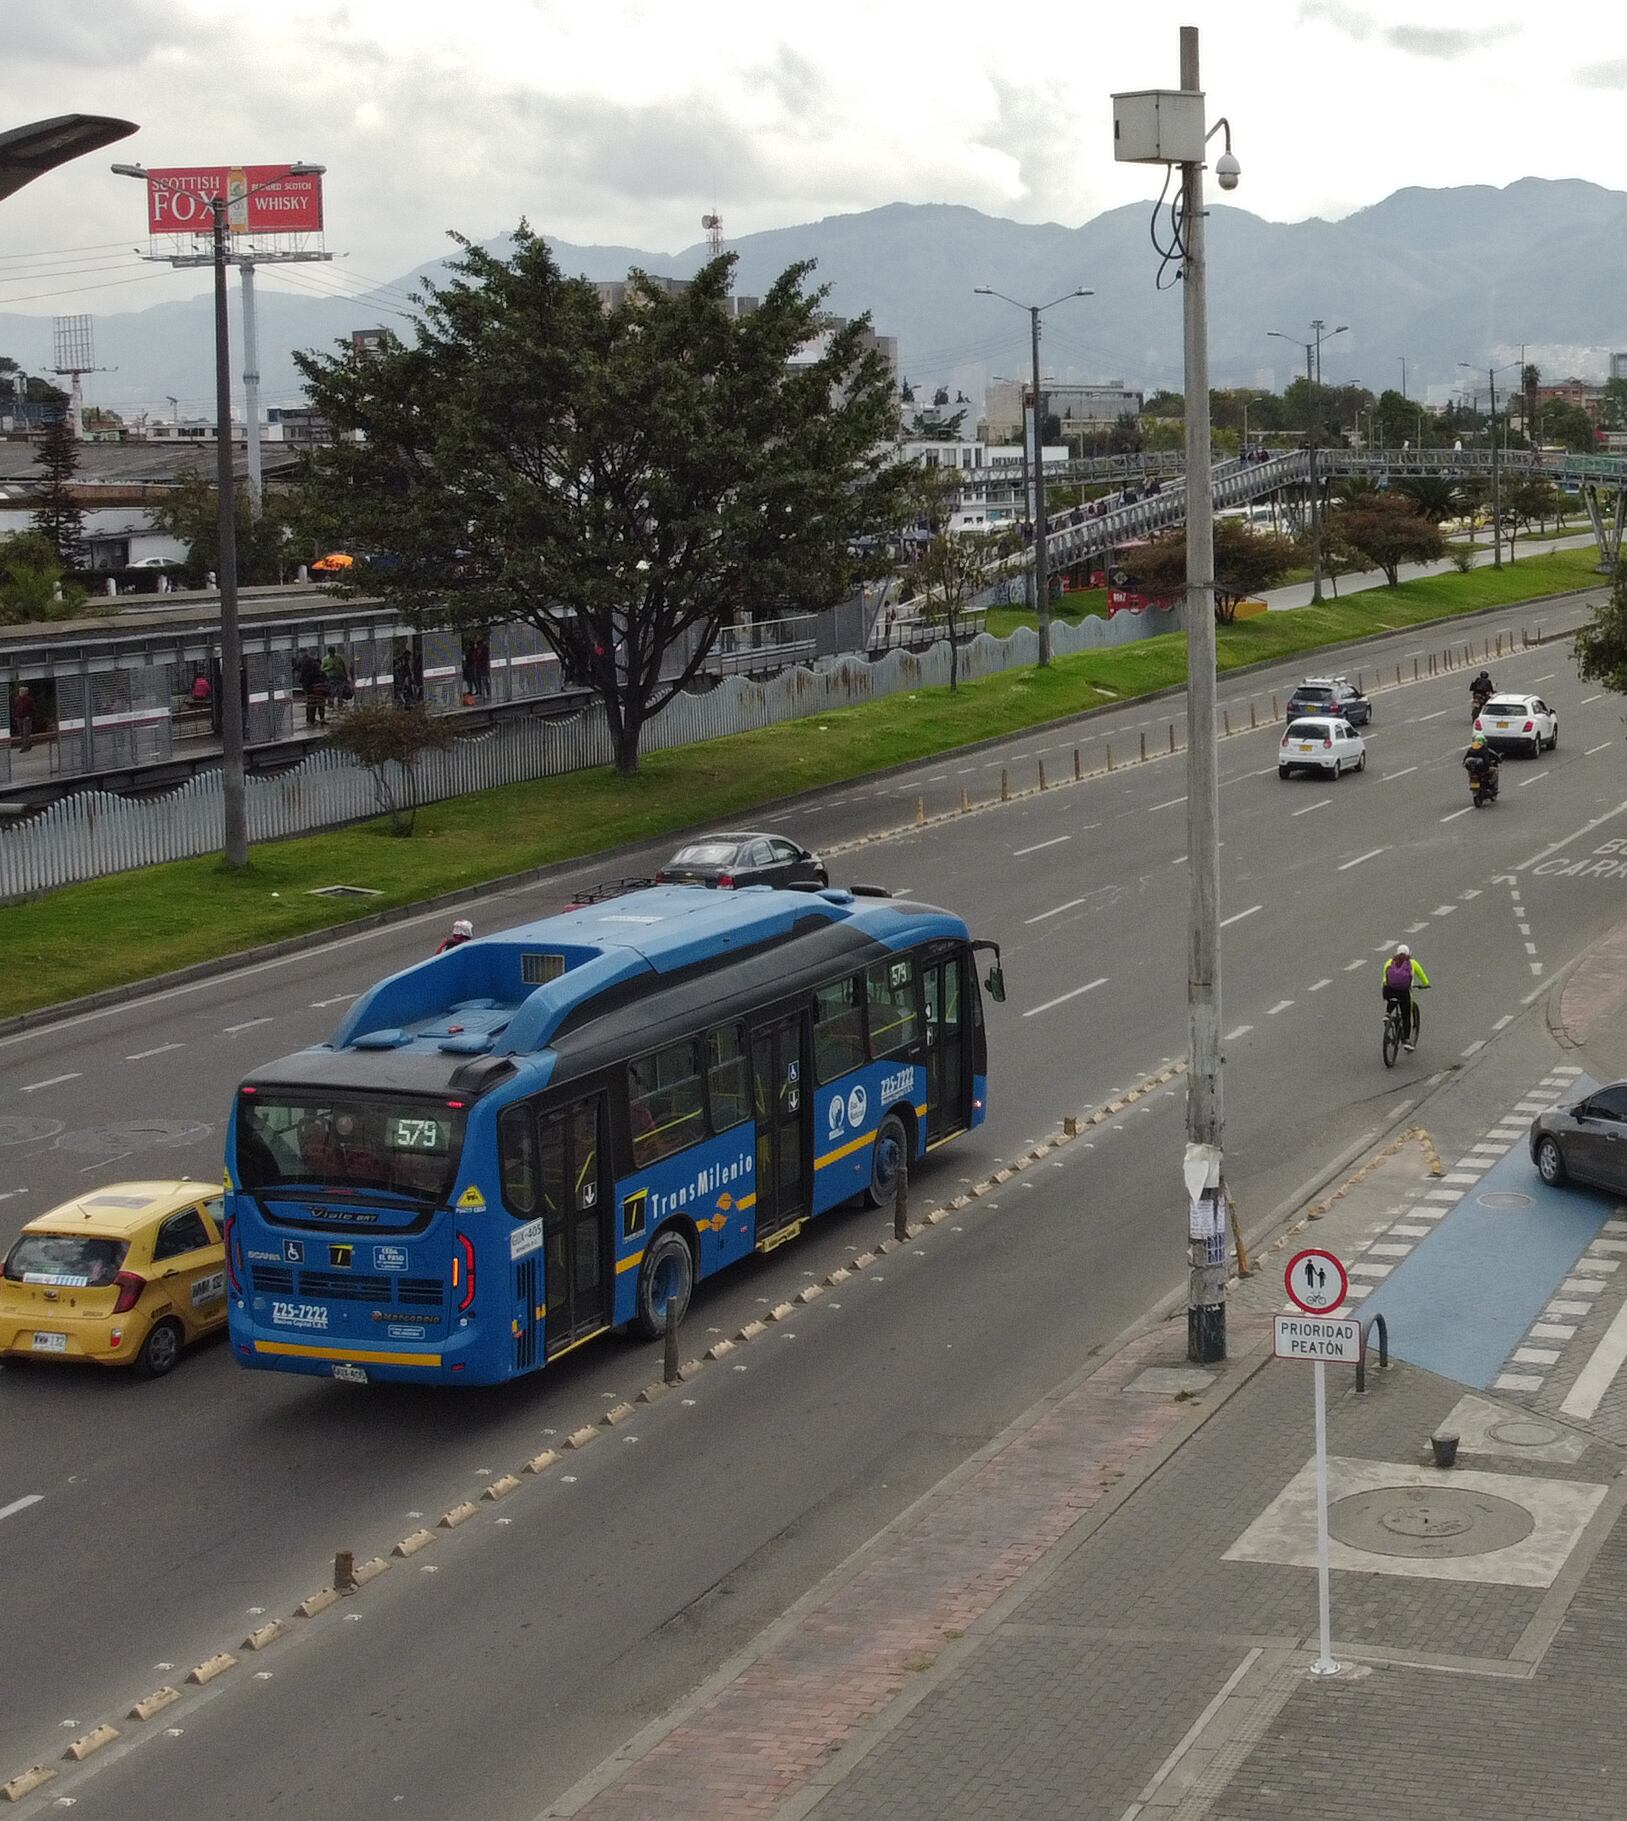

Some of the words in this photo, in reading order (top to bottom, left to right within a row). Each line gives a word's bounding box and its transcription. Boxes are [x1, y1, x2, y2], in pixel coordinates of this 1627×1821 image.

[152, 176, 220, 191] SCOTTISH
[153, 190, 220, 222] FOX
[254, 196, 309, 211] WHISKY
[398, 1119, 437, 1147] 579
[651, 1152, 753, 1219] TransMilenio
[271, 1301, 329, 1321] Z25-7222
[1281, 1322, 1353, 1339] PRIORIDAD
[1291, 1340, 1344, 1356] PEATÓN
